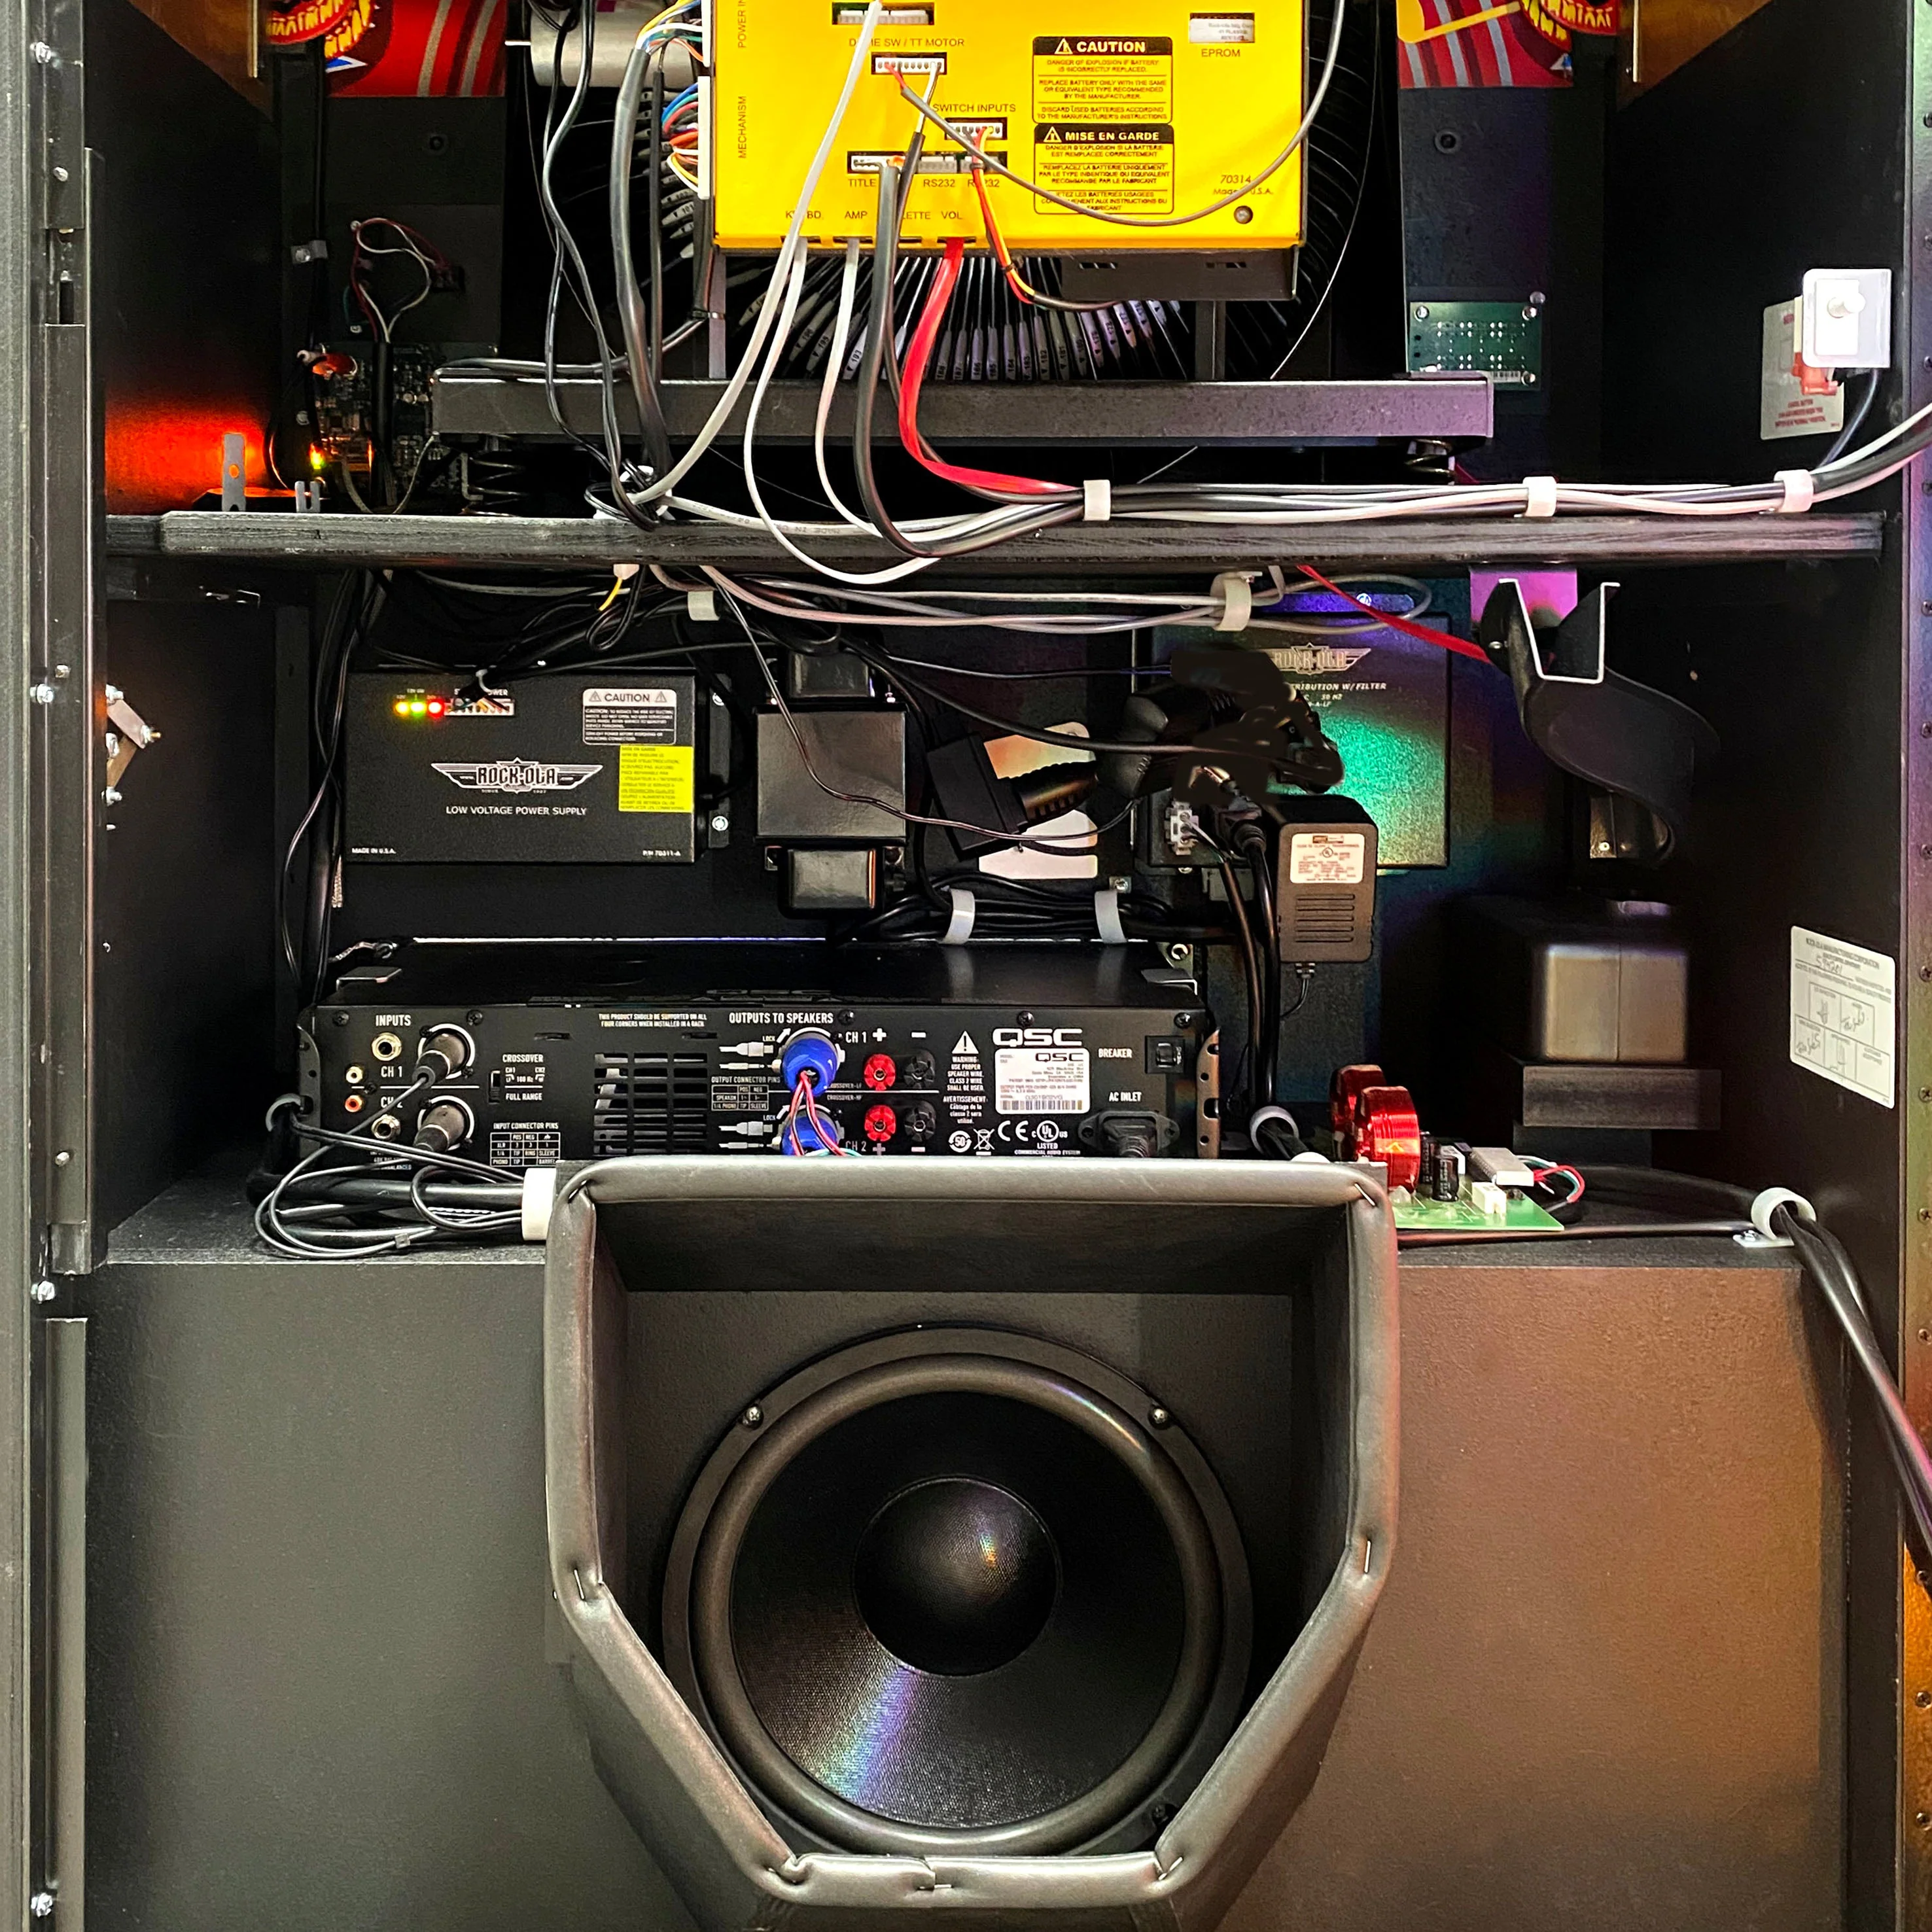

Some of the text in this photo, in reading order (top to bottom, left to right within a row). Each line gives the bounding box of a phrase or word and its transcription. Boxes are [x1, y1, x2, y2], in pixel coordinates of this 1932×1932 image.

[738, 10, 746, 48] POWER
[1076, 41, 1146, 53] CAUTION
[1201, 48, 1240, 58] EPROM
[933, 103, 1016, 113] SWITCH INPUTS
[738, 96, 746, 158] MECHANISM
[1065, 132, 1159, 141] MISE EN GARDE
[849, 179, 956, 188] TITLE RS232
[1220, 175, 1251, 183] 70314
[845, 211, 868, 220] AMP
[818, 336, 829, 348] 195
[604, 694, 650, 703] CAUTION
[446, 806, 588, 816] LOW VOLTAGE POWER SUPPLY
[376, 1014, 412, 1026] INPUTS
[729, 1013, 834, 1023] OUTPUTS TO SPEAKERS
[846, 1032, 866, 1043] CH 1
[992, 1028, 1083, 1047] QSC
[1035, 1053, 1083, 1063] QSC
[1098, 1048, 1133, 1059] BREAKER
[381, 1066, 403, 1078] CH 1
[1108, 1091, 1142, 1102] AC INLET
[846, 1141, 858, 1151] CH
